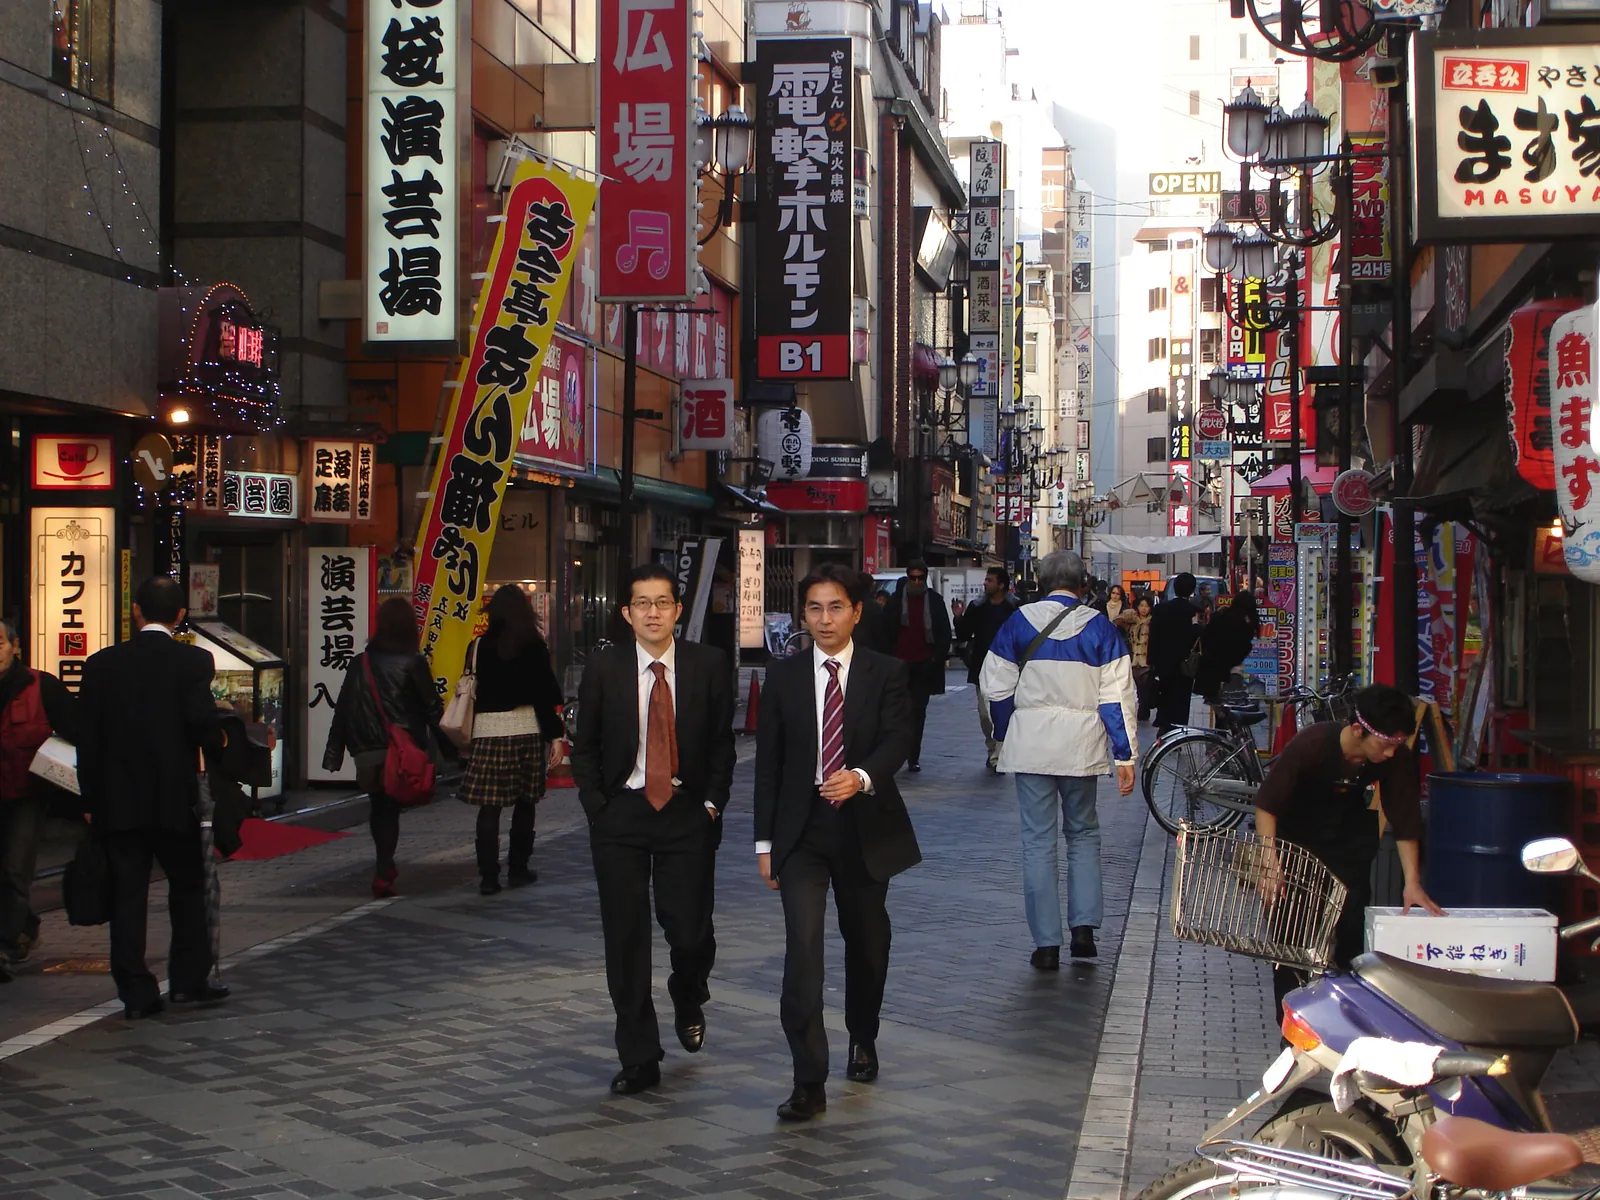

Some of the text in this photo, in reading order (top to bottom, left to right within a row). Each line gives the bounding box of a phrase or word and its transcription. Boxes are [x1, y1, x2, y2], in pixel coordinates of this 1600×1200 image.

[831, 50, 844, 109] やきとん
[1451, 63, 1520, 88] 立呑み
[830, 141, 844, 203] 炭火串焼
[1152, 174, 1219, 193] OPEN!
[976, 276, 990, 322] 酒菜家
[779, 340, 822, 373] B1
[683, 389, 727, 439] 酒
[1201, 418, 1224, 431] 消火栓
[1172, 426, 1180, 458] バッグ
[998, 508, 1018, 520] 2F
[320, 554, 356, 670] 演芸場
